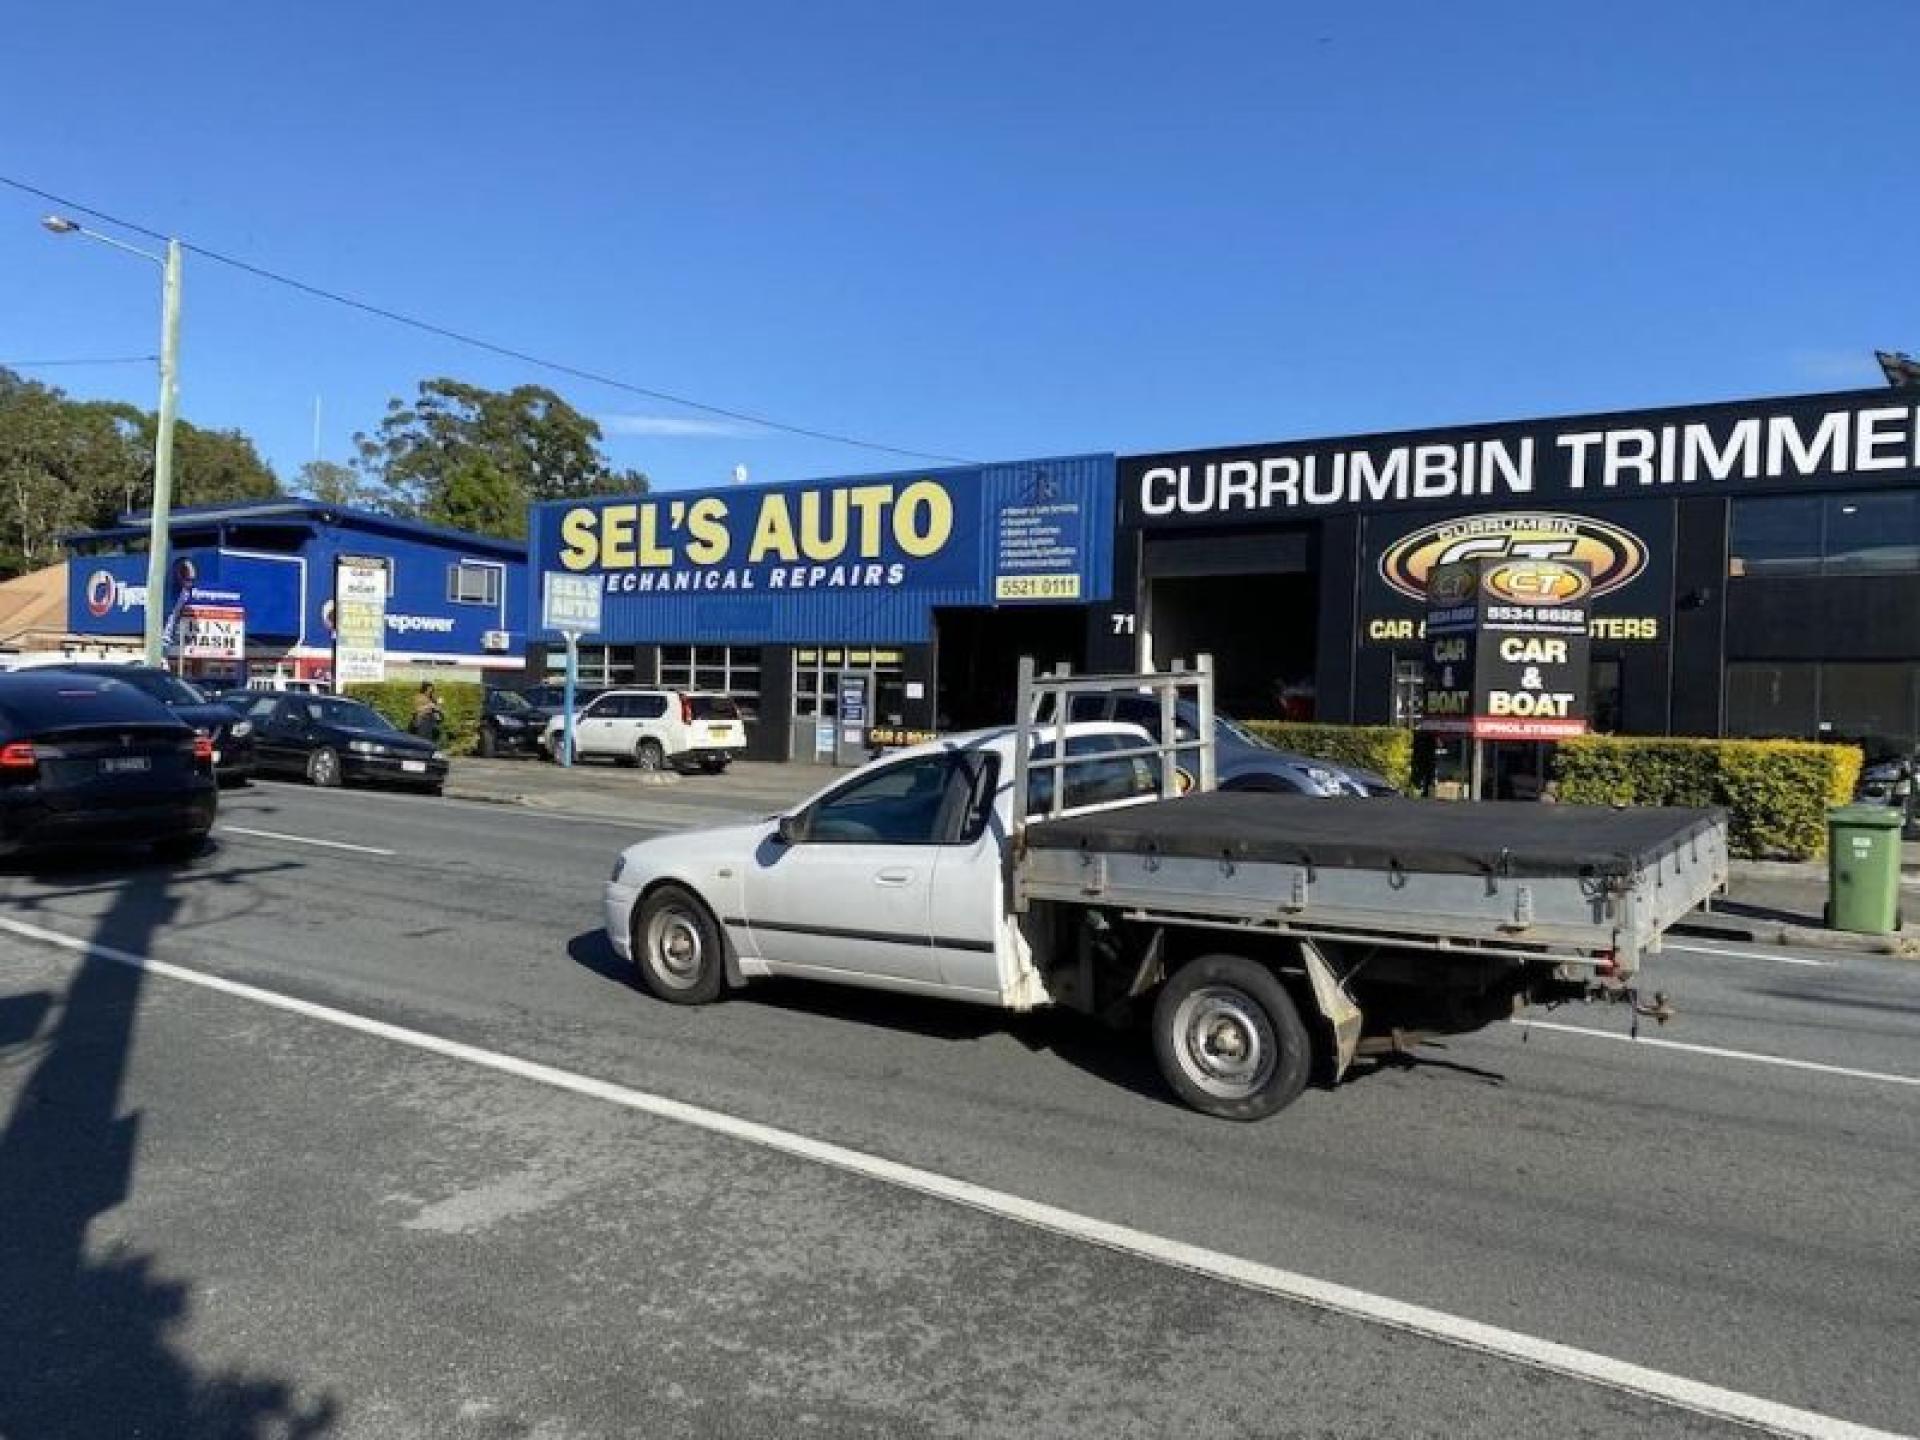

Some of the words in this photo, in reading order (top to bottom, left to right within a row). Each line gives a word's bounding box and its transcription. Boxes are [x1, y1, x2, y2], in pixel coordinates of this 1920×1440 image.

[1141, 437, 1534, 515] CURRUMBIN
[1557, 406, 1920, 487] TRIMME
[558, 498, 730, 571] SEL'S
[748, 480, 953, 562] AUTO
[605, 567, 755, 593] ECHANICAL
[769, 563, 905, 588] REPAIRS
[1002, 580, 1035, 595] 5521
[1041, 578, 1074, 594] 0111
[1111, 614, 1135, 634] 71
[1370, 618, 1414, 640] CAR
[1500, 637, 1568, 664] CAR
[1521, 666, 1543, 690] &
[1488, 690, 1575, 716] BOAT
